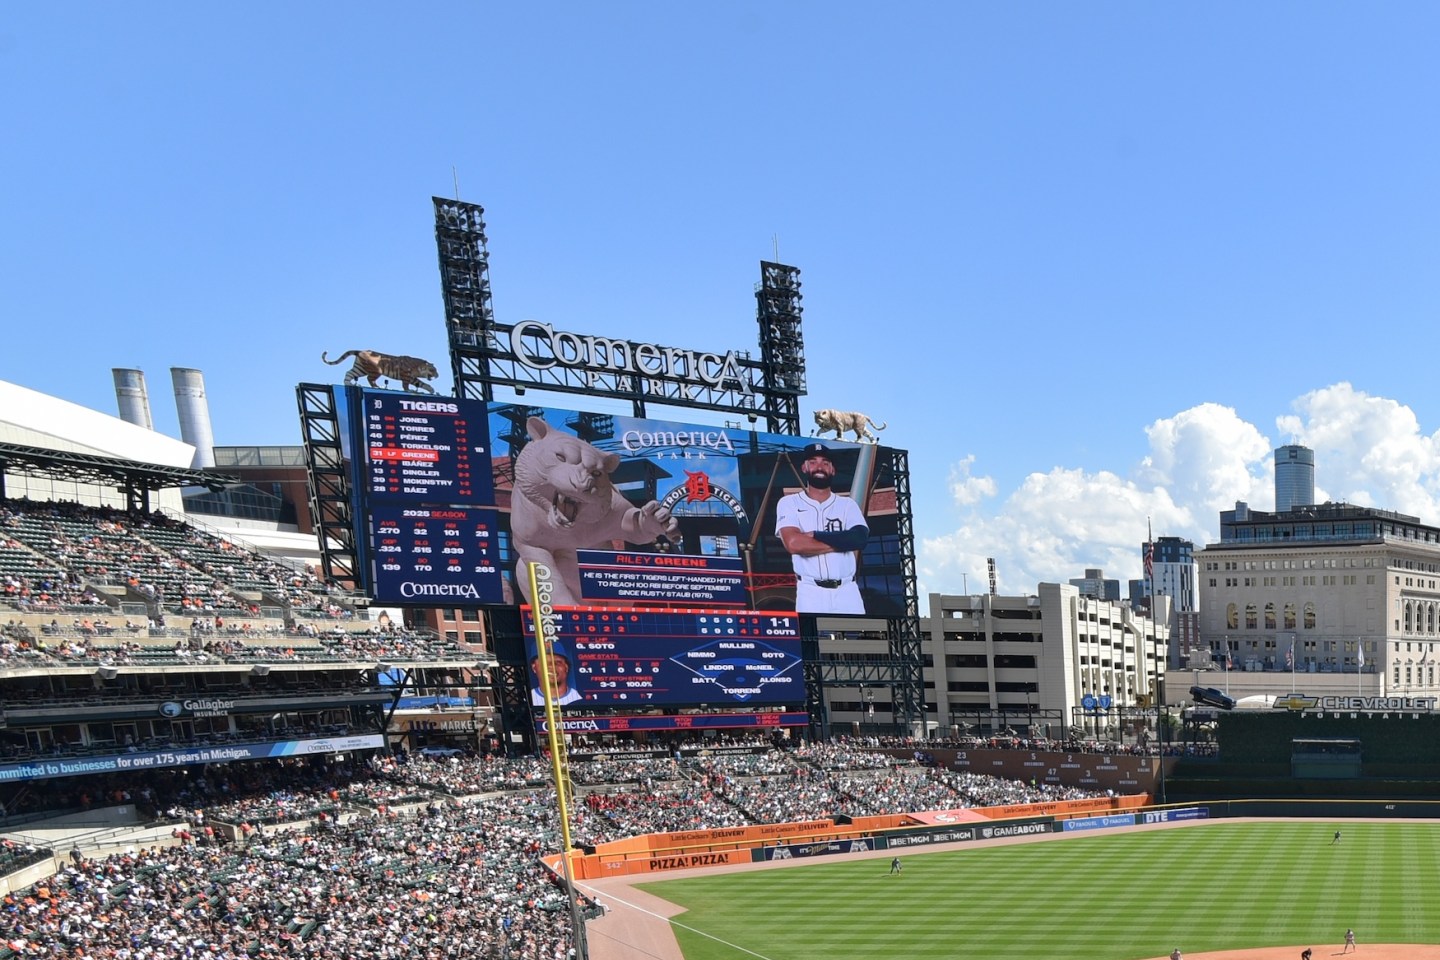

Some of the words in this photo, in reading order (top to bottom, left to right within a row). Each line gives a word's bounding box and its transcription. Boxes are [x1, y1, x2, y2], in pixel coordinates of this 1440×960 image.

[587, 371, 695, 400] PARK
[399, 400, 458, 413] TIGERS
[400, 425, 435, 433] TORRES
[400, 433, 428, 441] PÉREZ
[401, 443, 451, 451] TORKELSON
[401, 451, 436, 459] GREENE
[657, 451, 707, 460] PARK
[402, 460, 434, 468] IBÁÑEZ
[402, 469, 440, 477] DINGLER
[403, 478, 453, 486] MCKINSTRY
[403, 486, 428, 494] BÁEZ
[713, 486, 745, 519] TIGERS
[431, 511, 466, 519] SEASON
[377, 527, 400, 535] .270
[616, 555, 651, 564] RILEY
[654, 556, 707, 567] GREENE
[619, 573, 641, 581] FIRST
[642, 574, 667, 582] TIGERS
[667, 576, 716, 584] LEFT-HANDED
[716, 577, 741, 585] HITTER
[536, 581, 560, 642] Rocket
[770, 617, 790, 627] 1-1
[183, 700, 235, 712] Gallagher
[1320, 697, 1438, 710] CHEVROLET
[193, 710, 229, 718] INSURANCE
[1301, 712, 1420, 720] FOUNTAIN
[440, 720, 478, 731] MARKET
[715, 747, 753, 756] CHEVROLET
[957, 752, 967, 760] 23
[613, 752, 653, 761] CHEVROLET
[0, 764, 45, 780] mmitted
[47, 764, 58, 775] to
[60, 759, 116, 773] businesses
[117, 757, 132, 767] for
[133, 757, 154, 767] over
[156, 753, 174, 764] 175
[175, 752, 199, 766] years
[200, 750, 209, 760] in
[211, 747, 251, 760] Michigan.
[1146, 812, 1168, 823] DTE
[650, 858, 688, 870] PIZZA!
[691, 853, 729, 866] PIZZA!
